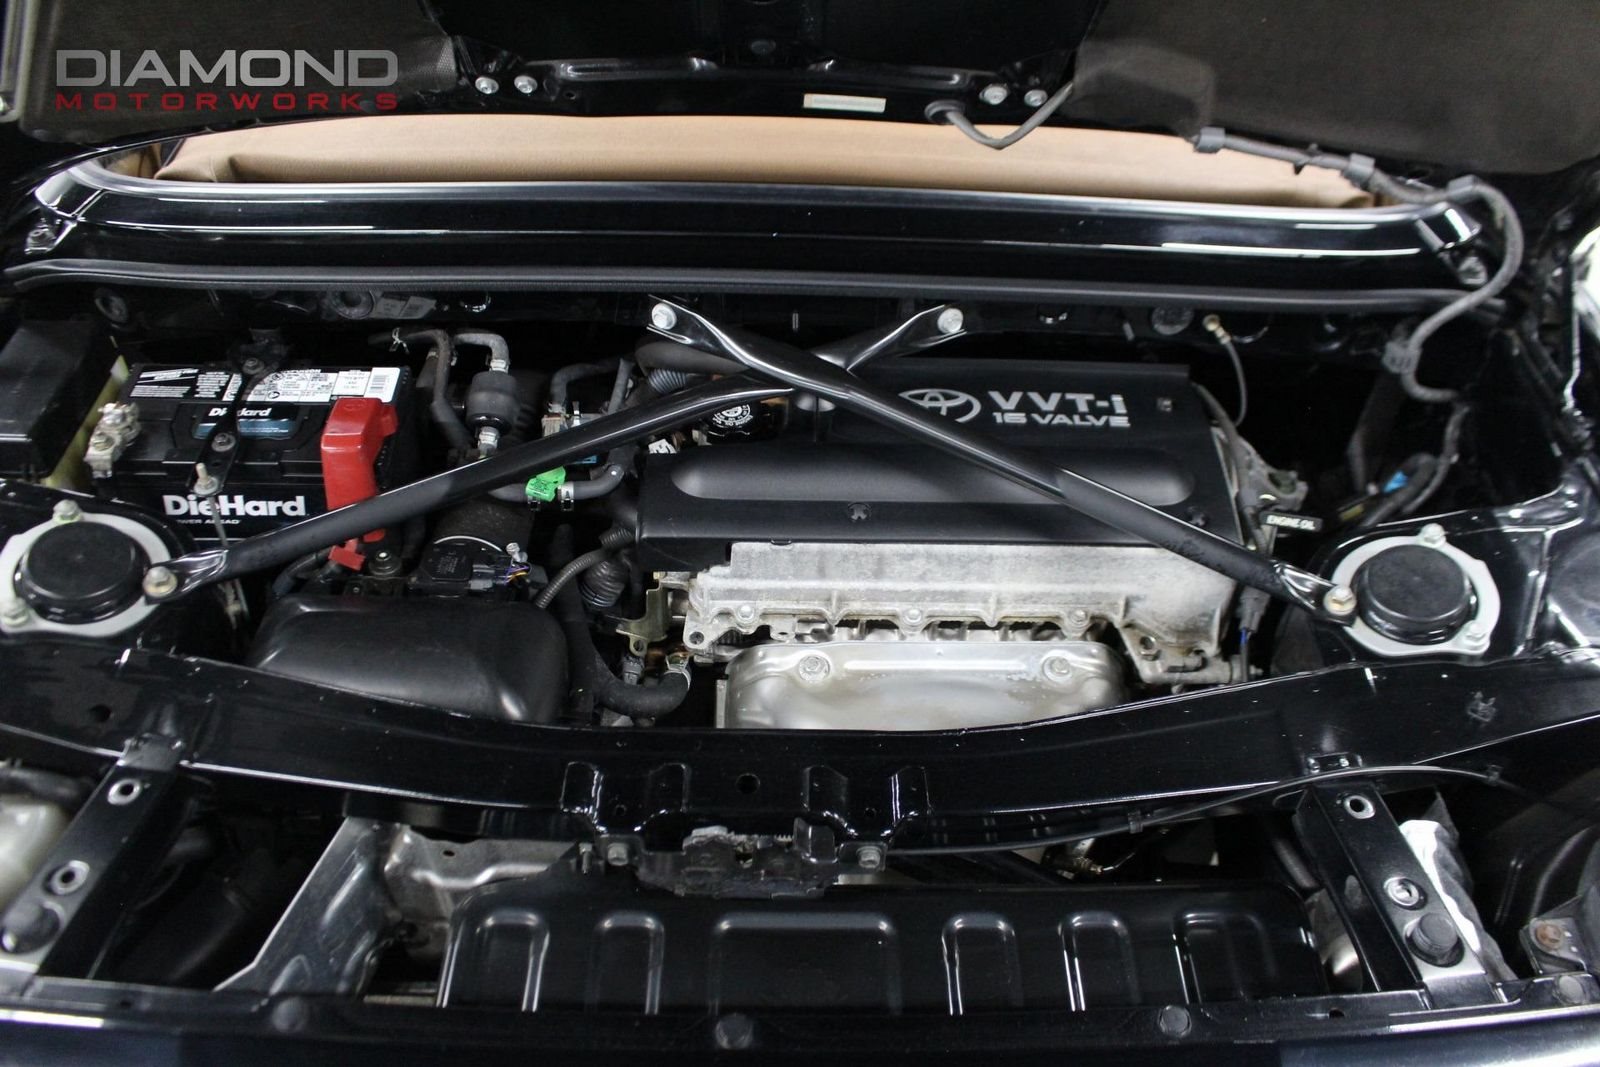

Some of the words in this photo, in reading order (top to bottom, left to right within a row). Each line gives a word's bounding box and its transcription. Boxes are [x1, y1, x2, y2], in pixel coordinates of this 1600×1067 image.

[993, 411, 1027, 424] 16
[1031, 413, 1131, 427] VALVE
[162, 494, 306, 516] DieHard
[1266, 514, 1300, 528] ENGINE
[1300, 519, 1316, 530] OIL
